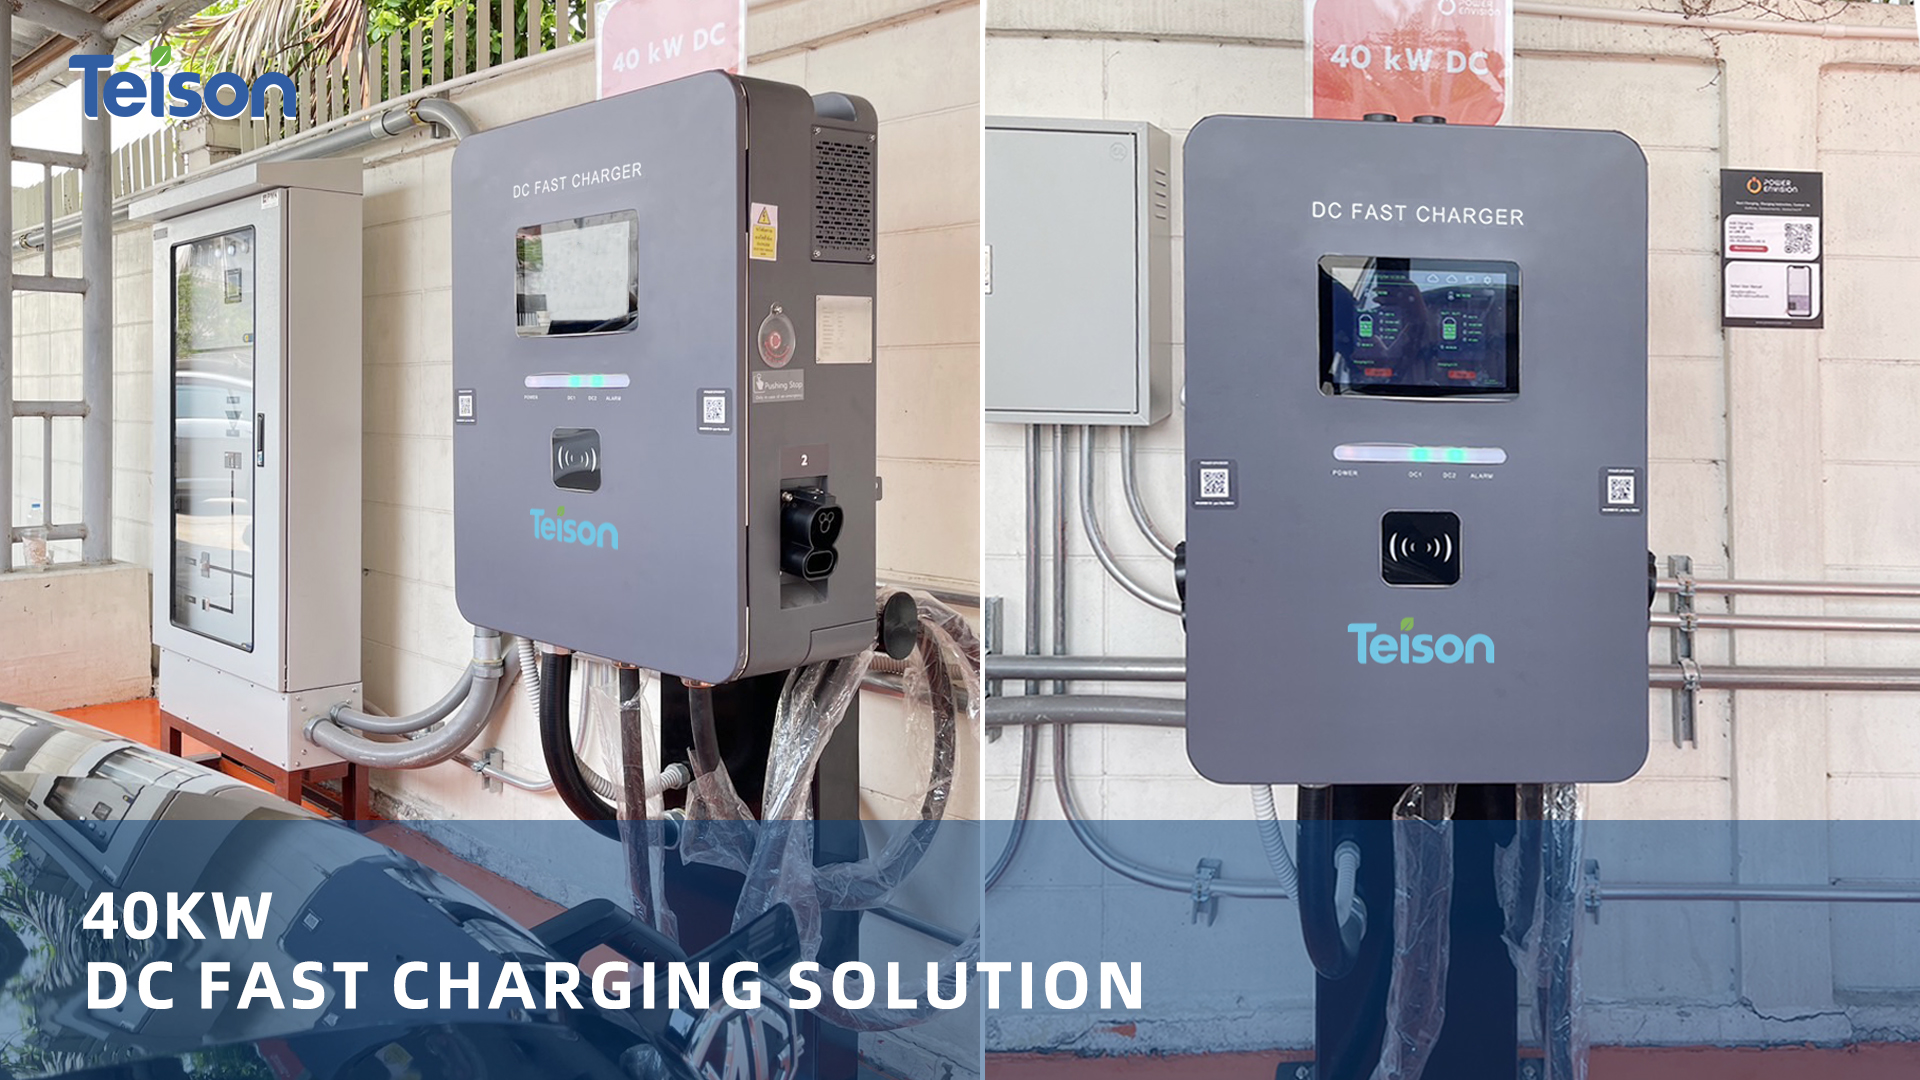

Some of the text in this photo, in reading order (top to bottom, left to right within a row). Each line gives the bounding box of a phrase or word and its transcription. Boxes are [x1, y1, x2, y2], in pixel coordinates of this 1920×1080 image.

[612, 22, 726, 72] 40 kW DC
[1330, 44, 1489, 75] 40 kW DC
[513, 161, 643, 199] DC FAST CHARGER
[1312, 201, 1525, 226] DC FAST CHARGER
[764, 380, 803, 391] Pushing Stop
[801, 454, 808, 467] 2
[1332, 469, 1359, 477] POWER
[529, 505, 619, 550] Teison
[1347, 616, 1495, 665] Teison
